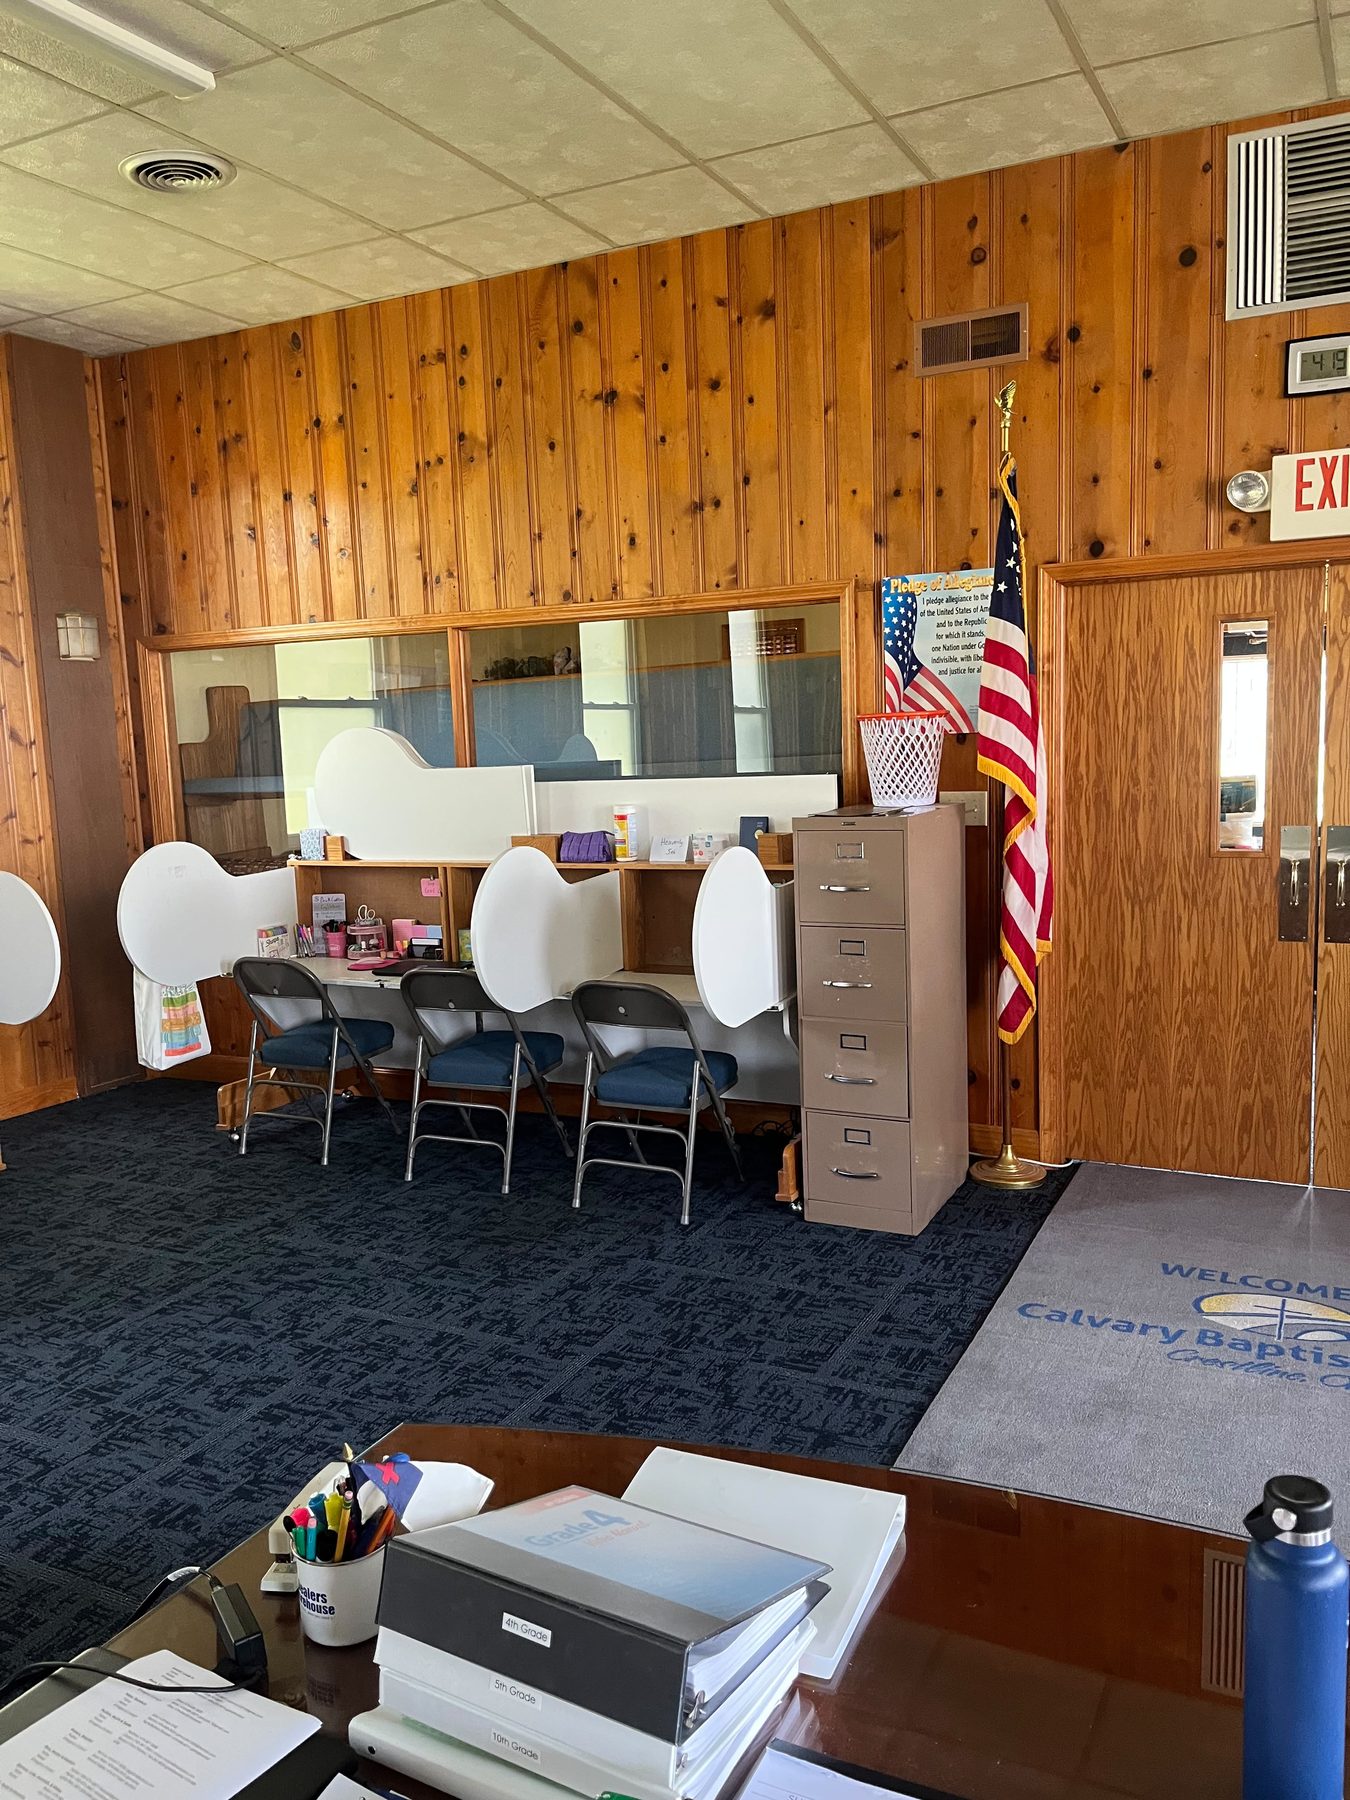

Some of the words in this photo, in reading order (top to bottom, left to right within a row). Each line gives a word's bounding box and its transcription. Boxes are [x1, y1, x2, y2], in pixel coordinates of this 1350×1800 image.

[890, 578, 928, 596] Pledge
[930, 575, 943, 591] of
[943, 573, 994, 592] Allegianc
[926, 596, 944, 606] pledge
[945, 594, 972, 606] allegiance
[926, 609, 935, 617] the
[936, 607, 954, 616] United
[955, 606, 972, 615] States
[964, 618, 987, 627] Republic
[961, 642, 976, 650] under
[931, 655, 959, 664] indivisible,
[948, 667, 966, 676] justice
[967, 666, 976, 674] for
[1161, 1262, 1350, 1300] WELCOME
[1017, 1303, 1188, 1345] Calvary
[1195, 1329, 1350, 1368] Baptis
[524, 1521, 599, 1547] Grade
[582, 1509, 632, 1527] 4
[300, 1584, 328, 1604] ealers
[505, 1618, 519, 1632] 4th
[520, 1623, 548, 1642] Grade
[494, 1679, 508, 1693] 5th
[509, 1685, 536, 1705] Grade
[492, 1732, 510, 1747] 10th
[511, 1741, 539, 1761] Grade
